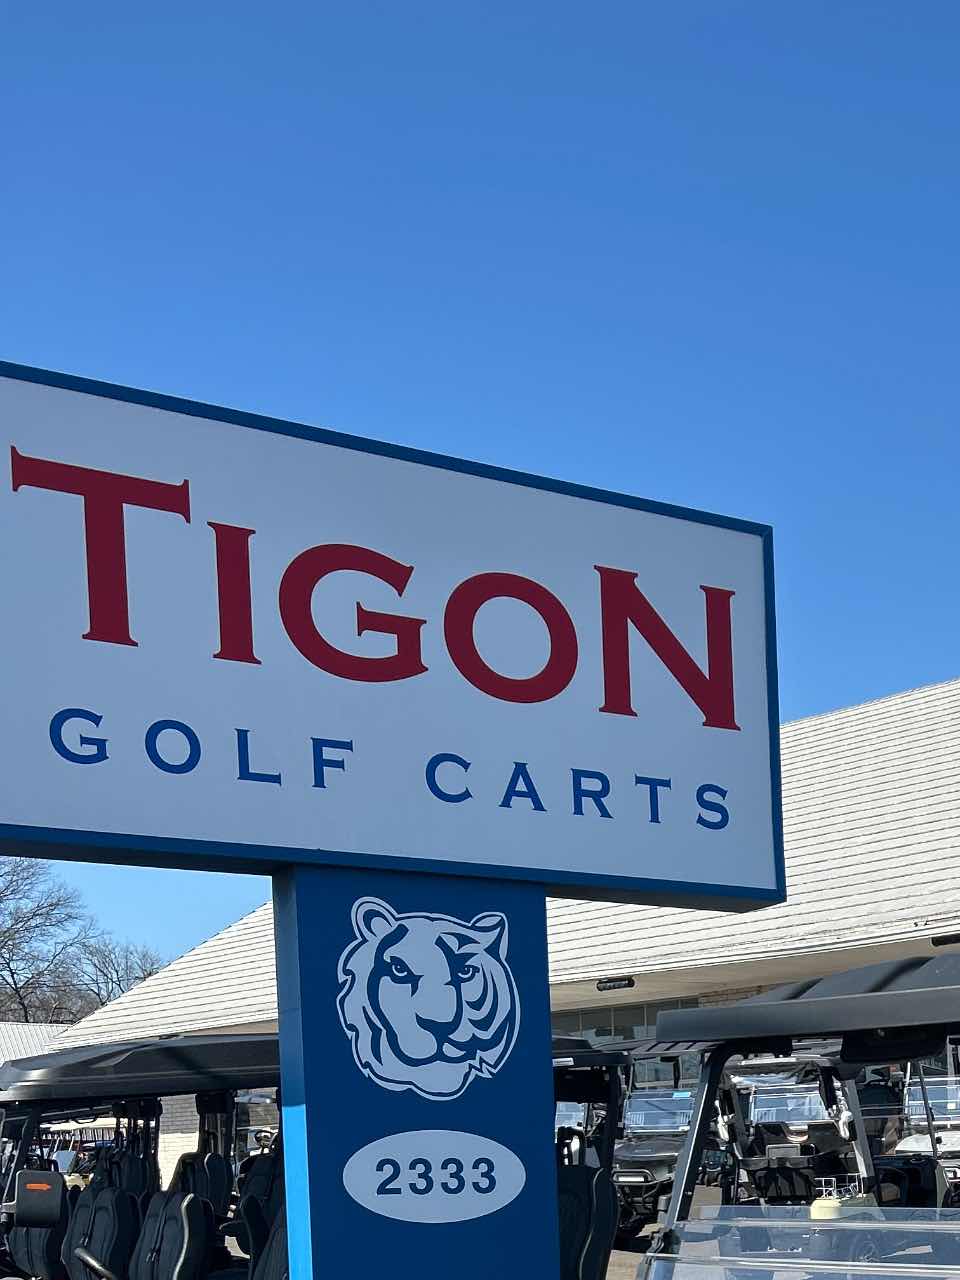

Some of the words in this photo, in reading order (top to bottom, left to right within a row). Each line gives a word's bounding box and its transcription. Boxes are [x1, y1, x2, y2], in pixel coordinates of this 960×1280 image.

[11, 445, 741, 731] TIGON
[48, 707, 355, 790] GOLF
[424, 751, 731, 831] CARTS
[375, 1157, 497, 1196] 2333
